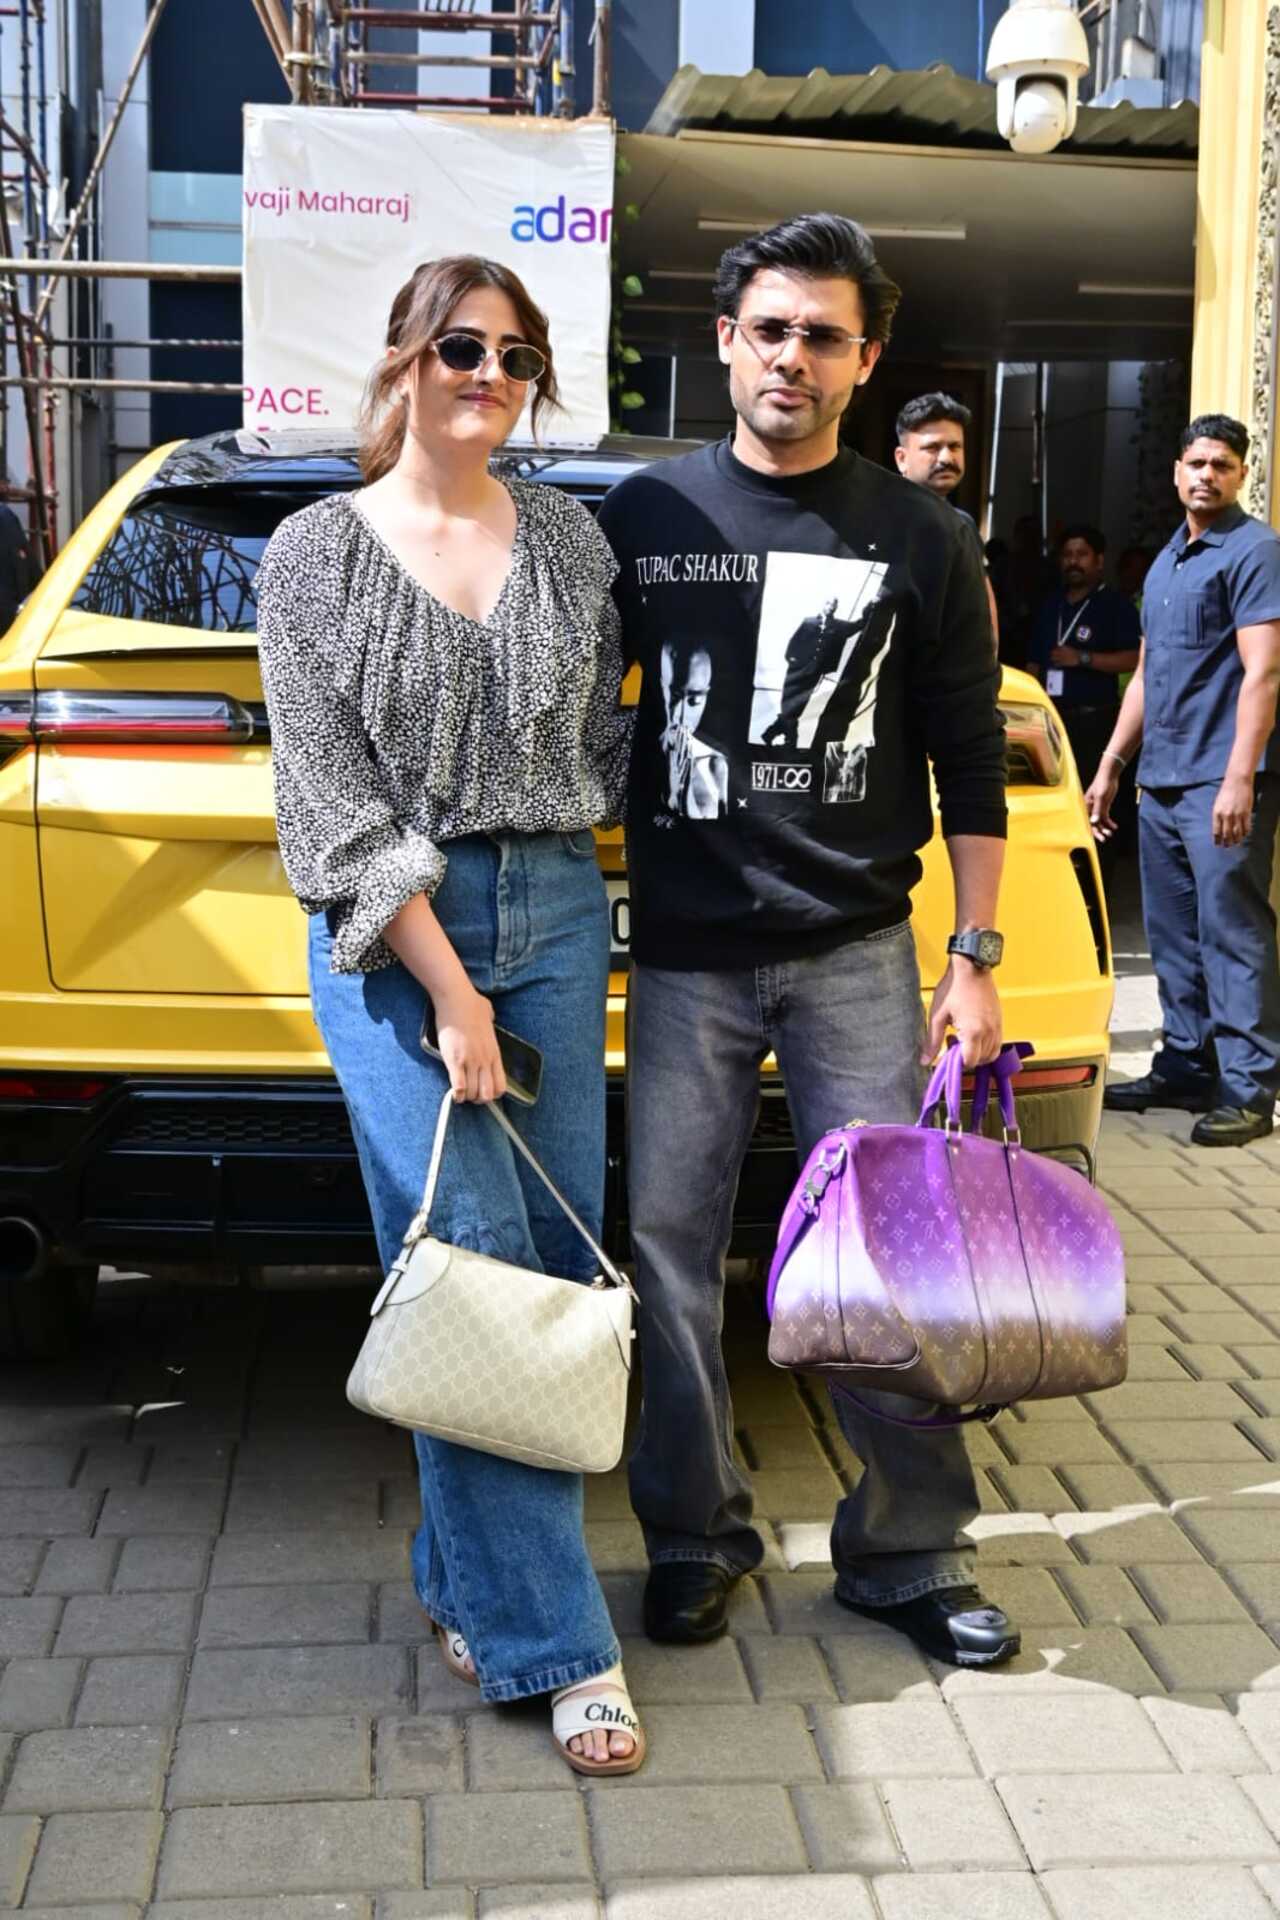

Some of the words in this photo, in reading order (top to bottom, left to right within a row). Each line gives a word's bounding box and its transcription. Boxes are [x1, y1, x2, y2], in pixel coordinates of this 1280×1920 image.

[298, 190, 409, 222] Maharaj
[635, 554, 681, 585] TUPAC
[683, 553, 759, 583] SHAKUR
